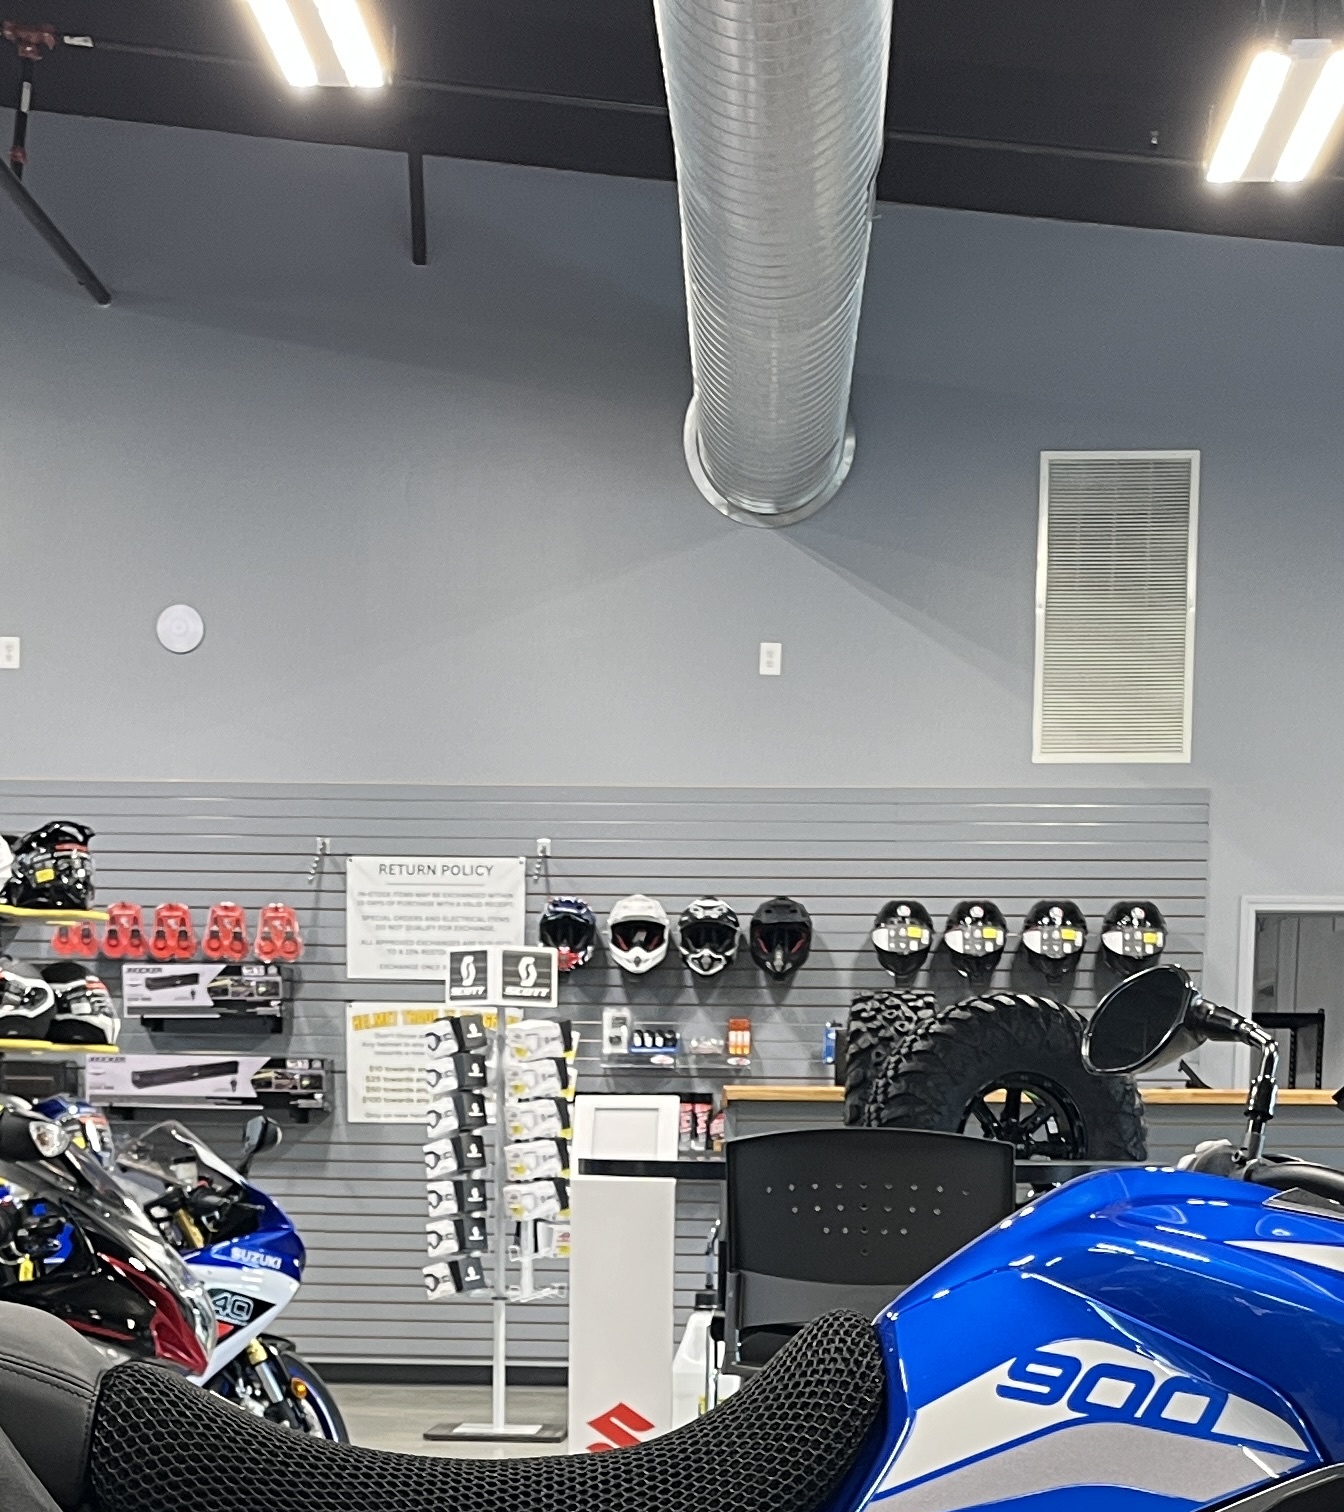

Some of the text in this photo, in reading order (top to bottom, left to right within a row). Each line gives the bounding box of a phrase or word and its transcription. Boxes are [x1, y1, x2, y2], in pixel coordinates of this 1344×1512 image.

[379, 864, 494, 876] RETURN POLICY
[451, 986, 485, 996] SCOTT
[503, 986, 549, 997] SCOTT
[230, 1246, 283, 1269] SUZUKI
[996, 1350, 1229, 1436] 900
